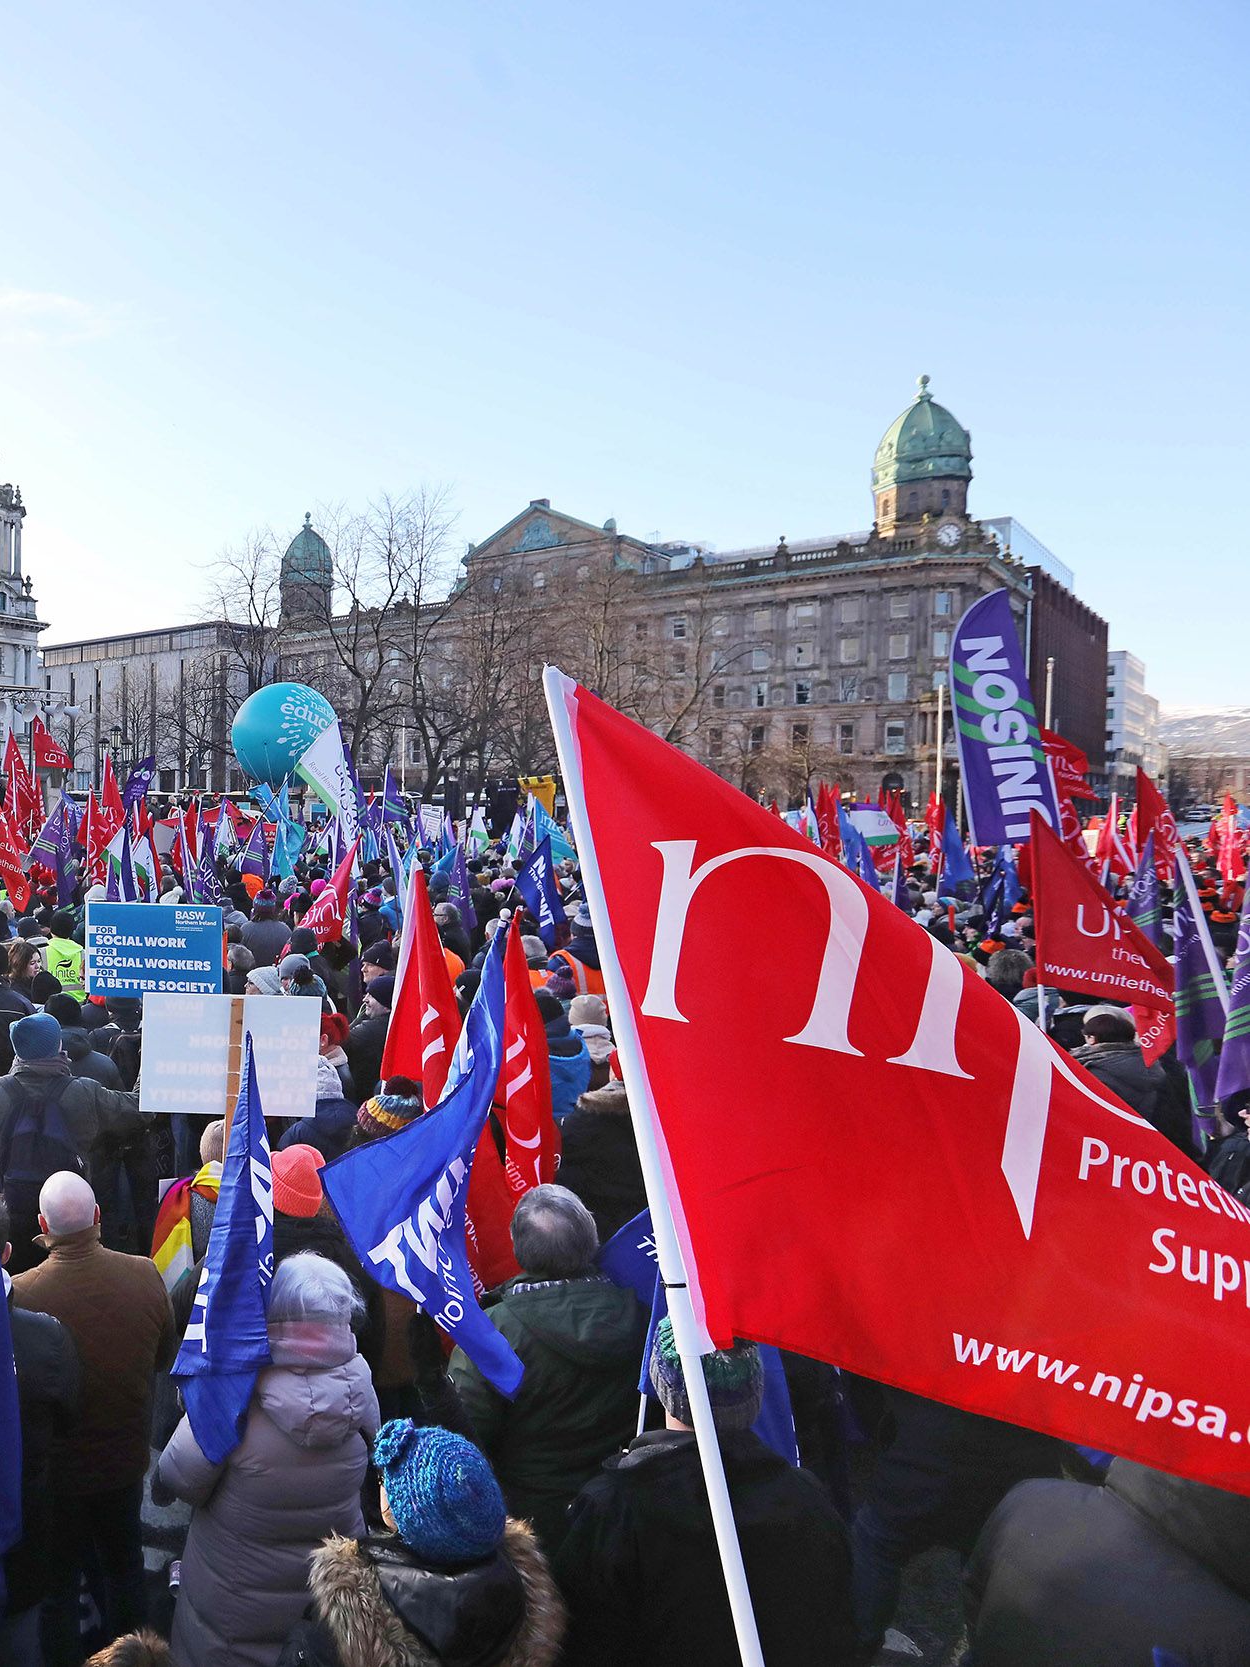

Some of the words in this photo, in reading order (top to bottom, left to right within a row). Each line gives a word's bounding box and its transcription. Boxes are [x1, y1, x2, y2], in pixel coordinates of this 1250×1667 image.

[280, 702, 329, 730] educ
[960, 635, 1052, 839] UNISON
[175, 911, 206, 920] BASW
[95, 935, 143, 947] SOCIAL
[144, 937, 187, 948] WORK
[95, 956, 143, 968] SOCIAL
[144, 958, 211, 972] WORKERS
[96, 969, 114, 977] FOR
[96, 978, 106, 988] A
[107, 978, 157, 990] BETTER
[158, 981, 217, 993] SOCIETY
[1078, 1136, 1250, 1225] Protecti
[1148, 1227, 1250, 1309] Sup
[952, 1332, 1250, 1445] www.nipsa.
